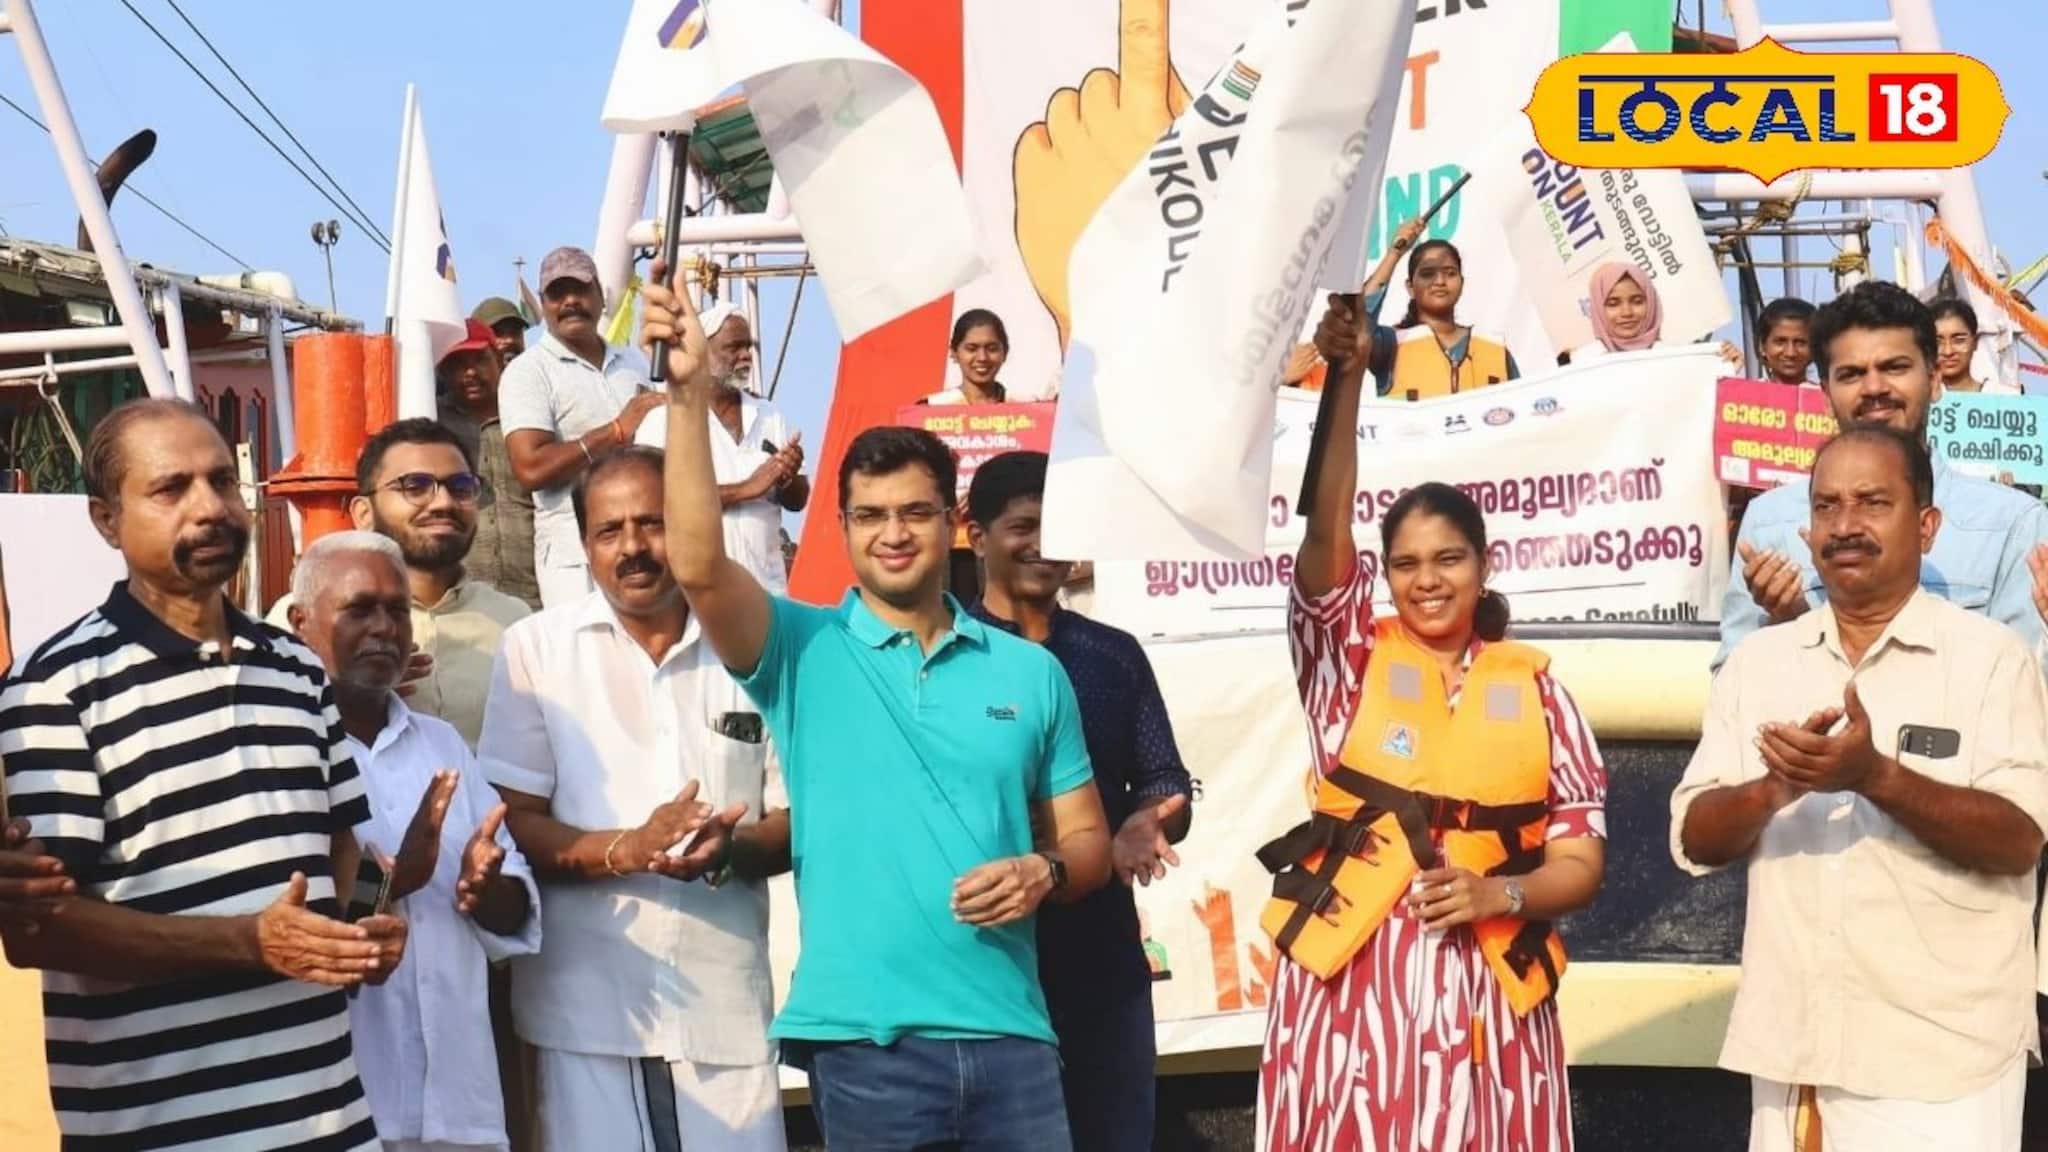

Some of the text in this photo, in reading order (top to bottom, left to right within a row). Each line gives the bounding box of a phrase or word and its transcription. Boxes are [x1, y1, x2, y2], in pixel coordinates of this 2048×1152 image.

[1522, 148, 1573, 263] ON KERALA
[1553, 161, 1605, 250] OUNT
